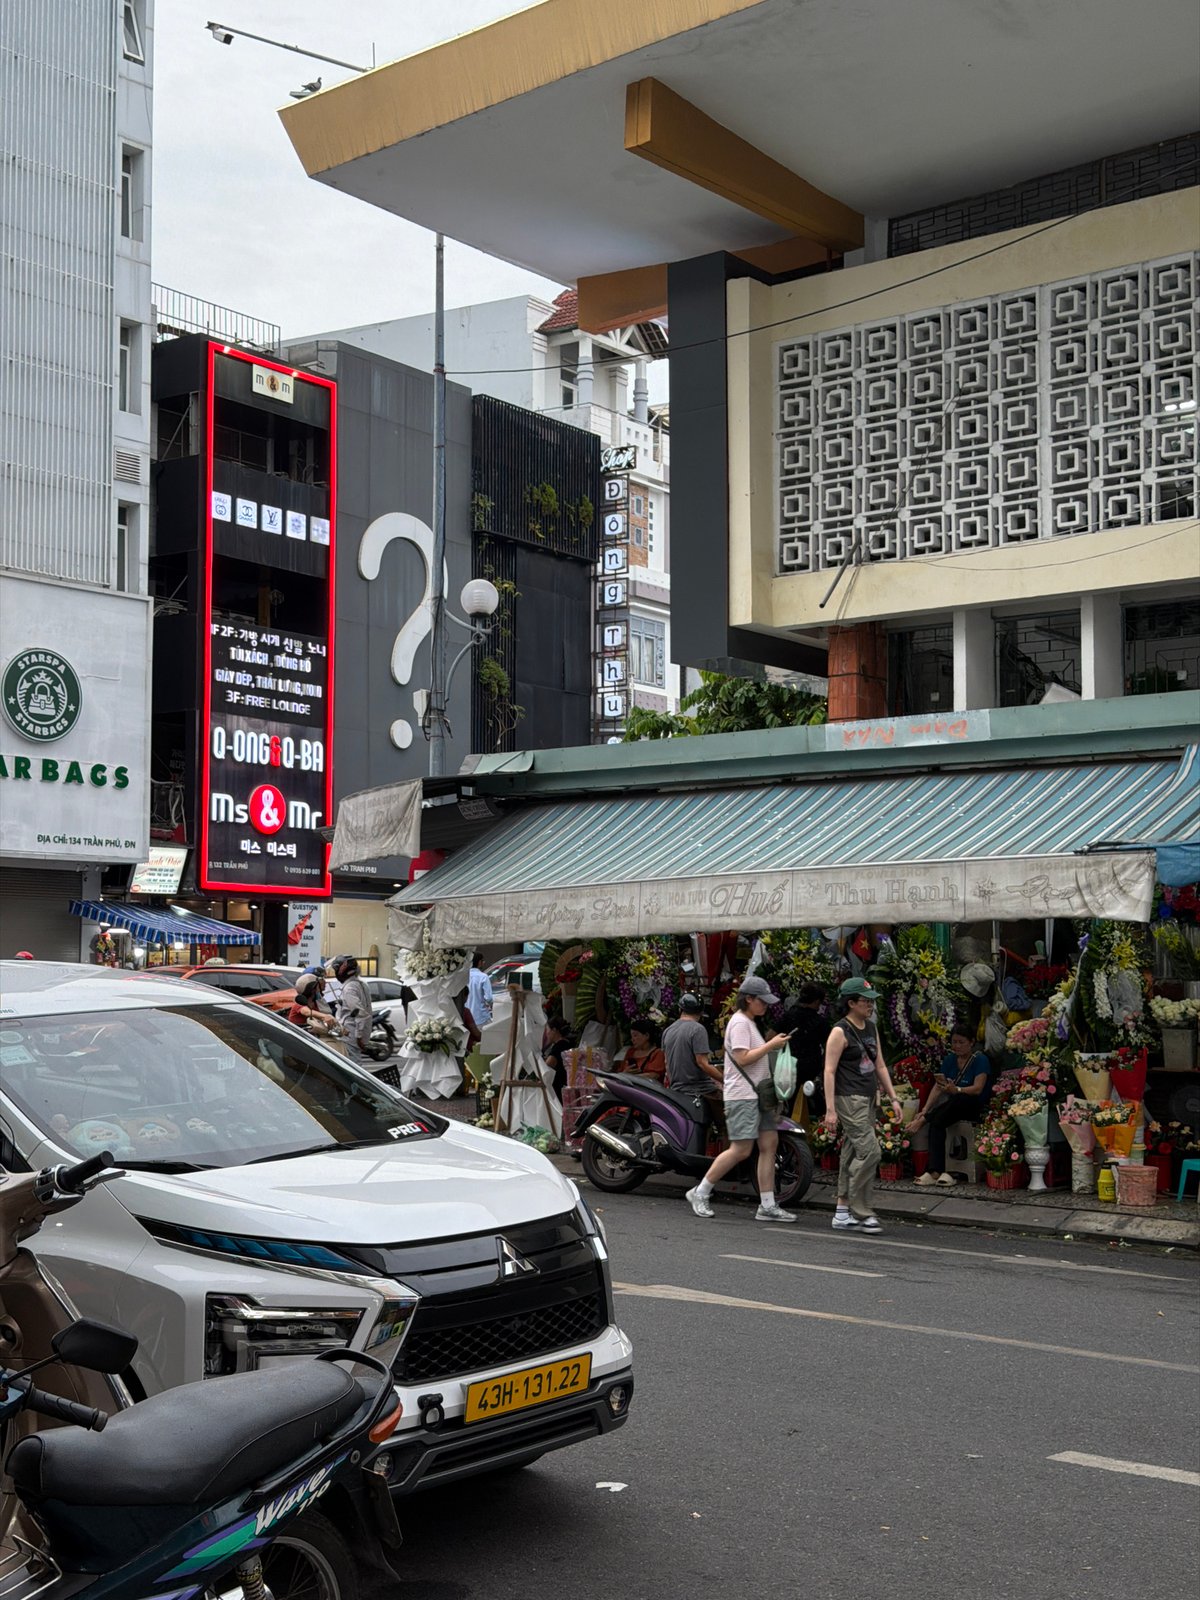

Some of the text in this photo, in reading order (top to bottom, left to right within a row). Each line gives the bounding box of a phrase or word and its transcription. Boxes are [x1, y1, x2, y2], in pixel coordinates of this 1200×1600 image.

[600, 447, 634, 472] Shop
[17, 653, 67, 674] STARSPA
[245, 694, 270, 708] FREE
[15, 712, 69, 736] STARBAGS
[69, 837, 81, 845] 134
[124, 840, 136, 849] ĐN
[240, 839, 261, 854] 미스
[709, 878, 790, 918] Huế
[824, 876, 960, 910] Thu Hạnh
[478, 1363, 581, 1411] 43H-131.22
[255, 1463, 334, 1536] Wave
[297, 1480, 332, 1516] 110
